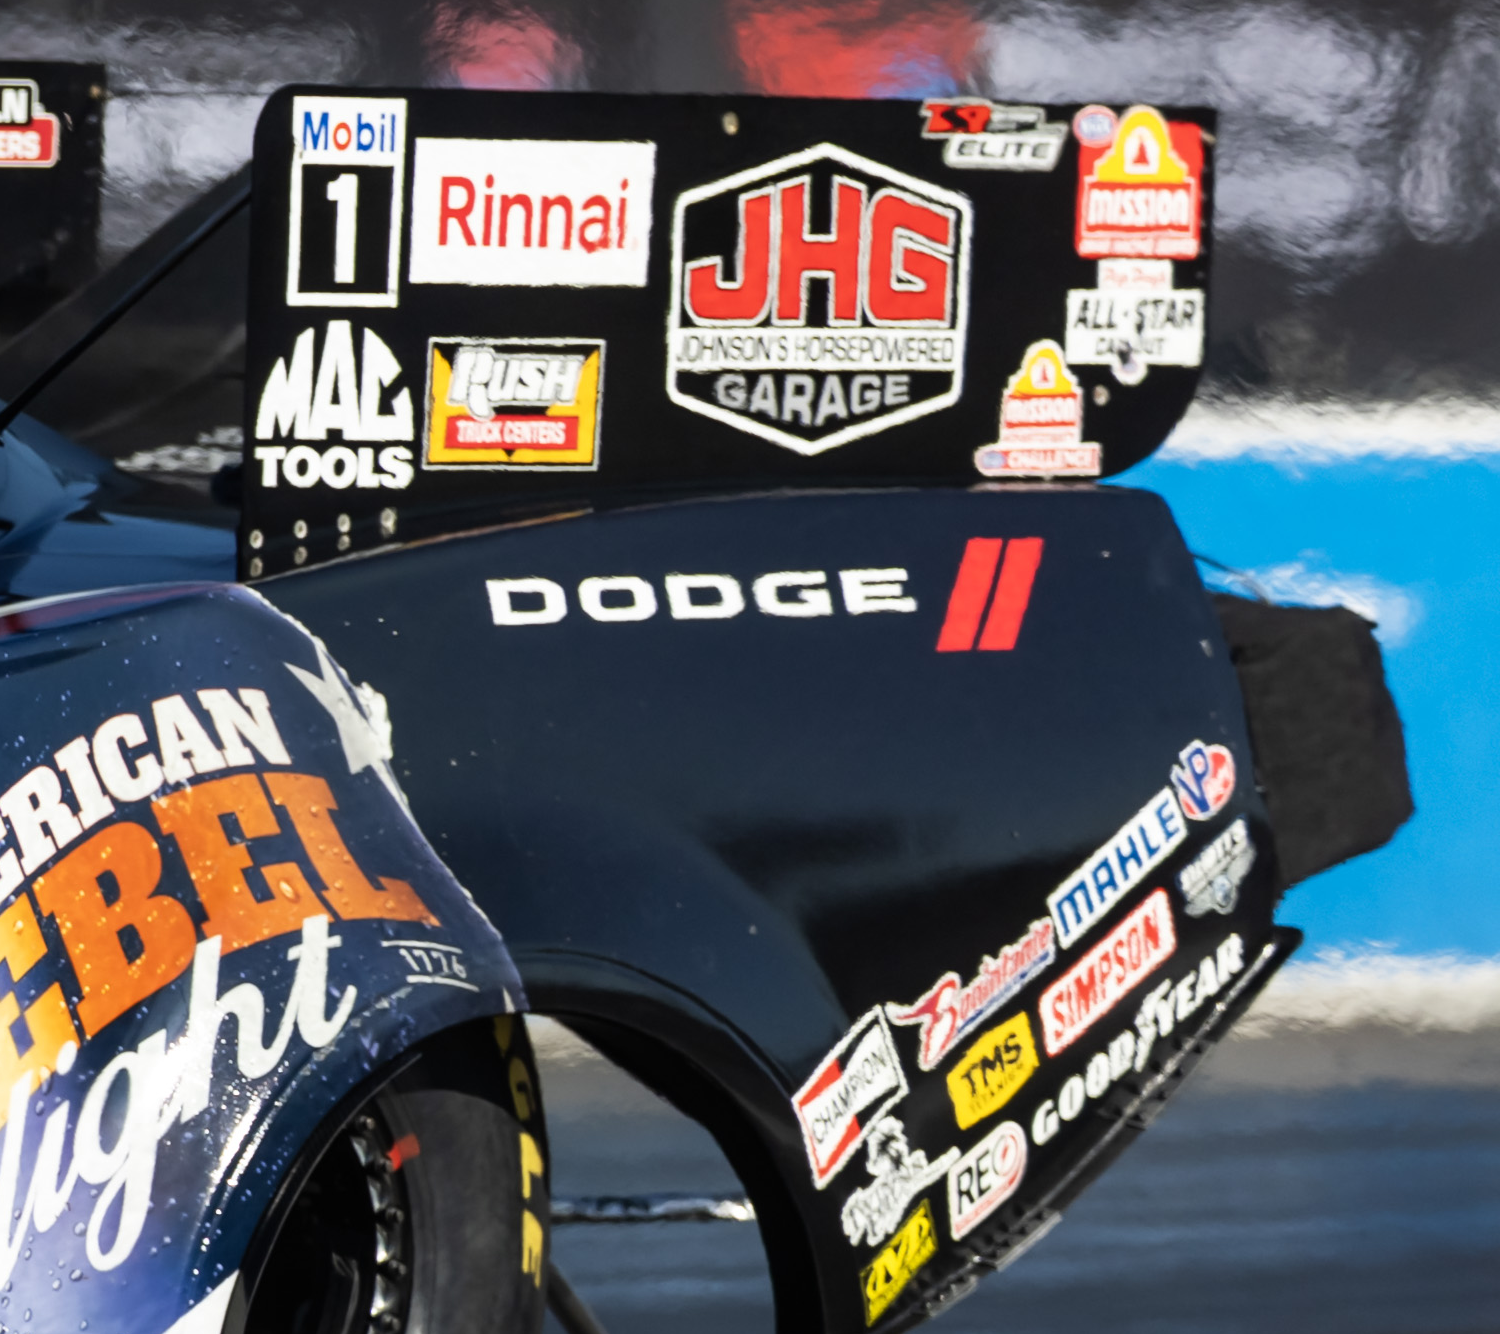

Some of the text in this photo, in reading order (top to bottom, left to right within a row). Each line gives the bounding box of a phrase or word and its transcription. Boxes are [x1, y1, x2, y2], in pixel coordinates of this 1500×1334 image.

[302, 111, 397, 152] Mobil
[957, 139, 1054, 159] ELITE
[326, 172, 359, 284] 1
[438, 173, 630, 253] Rinnai
[685, 174, 956, 328] JHG
[255, 320, 414, 440] MAC
[676, 335, 954, 363] JOHNSON'S HORSEPOWERED
[456, 419, 567, 445] TRUCK CENTERS
[714, 373, 911, 426] GARAGE
[254, 446, 415, 489] TOOLS
[486, 568, 918, 627] DODGE
[1056, 797, 1183, 939] MAHLE
[398, 946, 470, 981] 1776
[1050, 910, 1163, 1041] SIMPSON
[961, 1031, 1023, 1097] TMS
[1032, 932, 1246, 1146] GOODYEAR
[810, 1043, 890, 1147] CHAMPION
